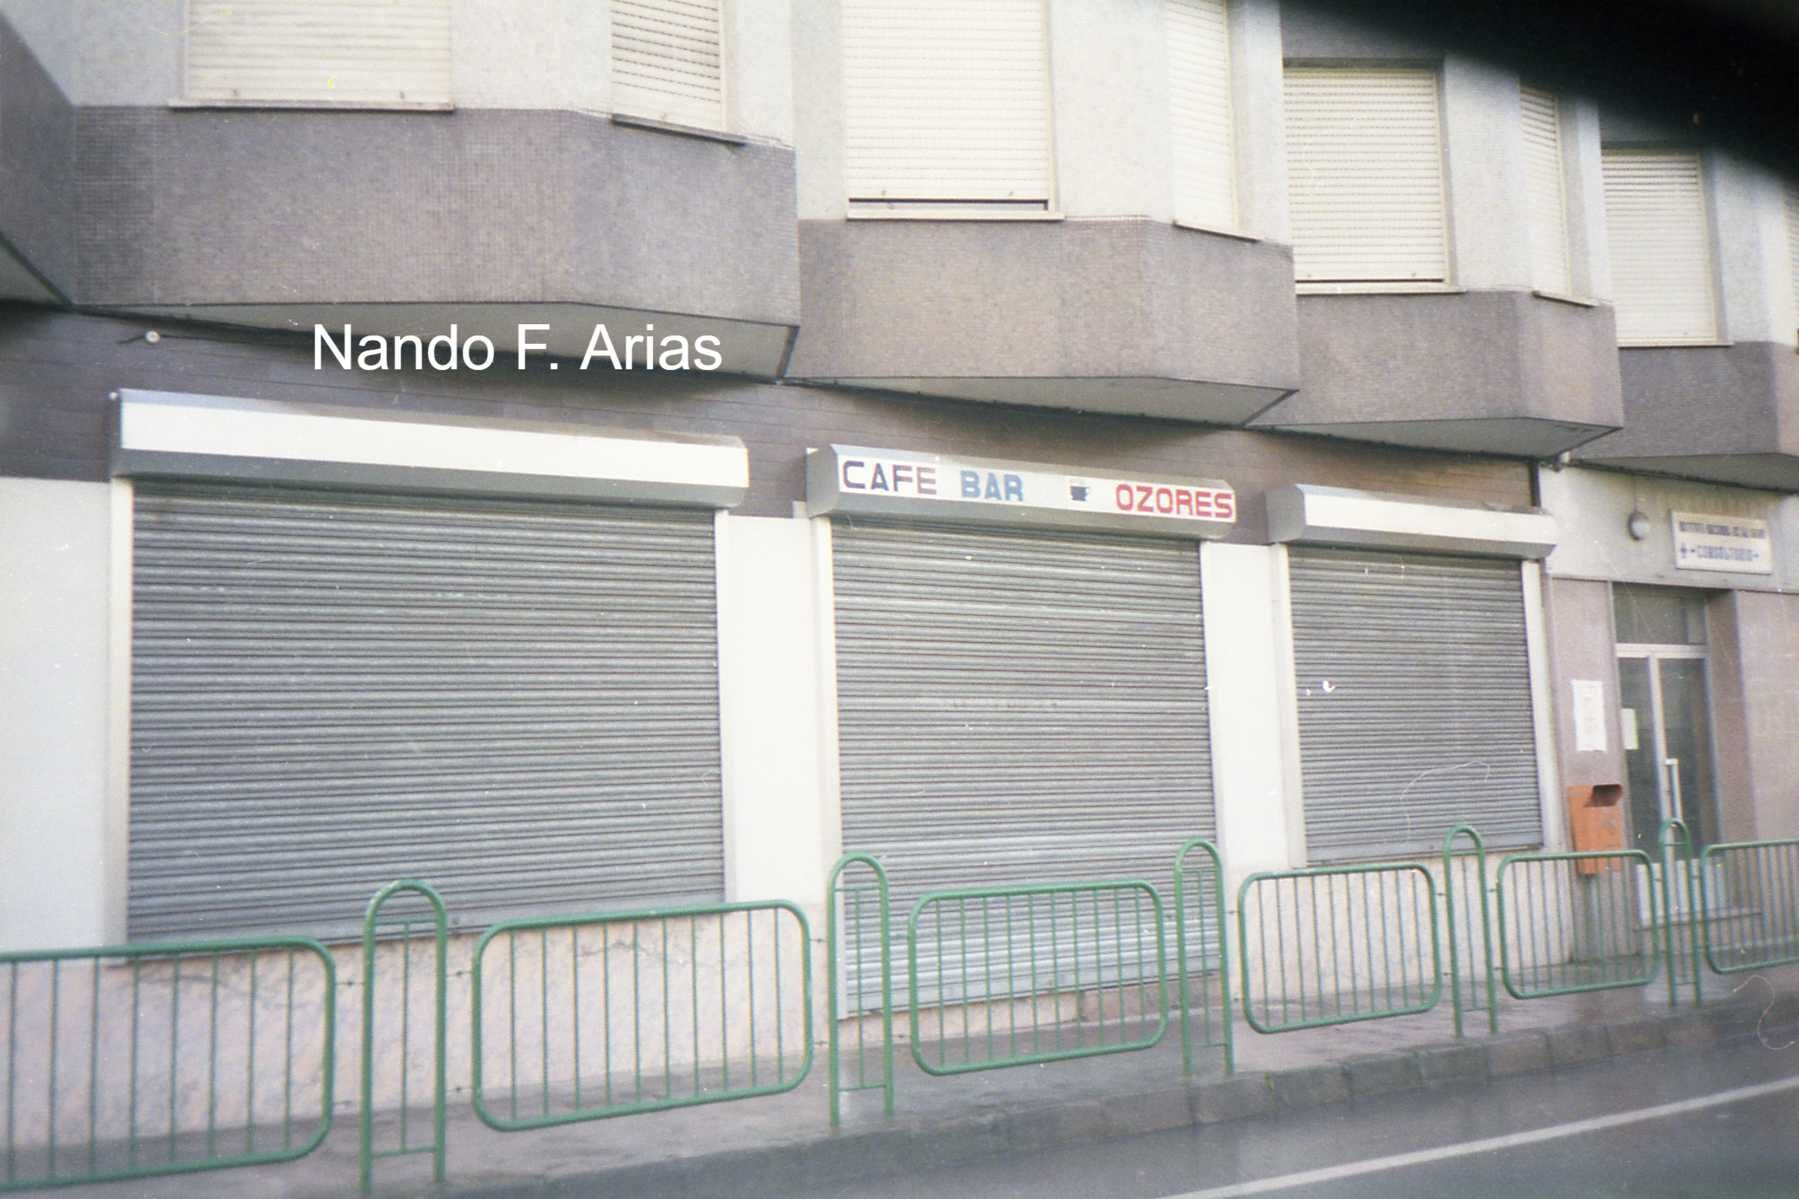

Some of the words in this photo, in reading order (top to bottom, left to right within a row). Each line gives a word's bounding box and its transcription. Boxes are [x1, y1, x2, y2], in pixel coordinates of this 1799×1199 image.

[842, 460, 937, 495] CAFE
[960, 469, 1024, 502] BAR
[1115, 484, 1233, 519] OZORES
